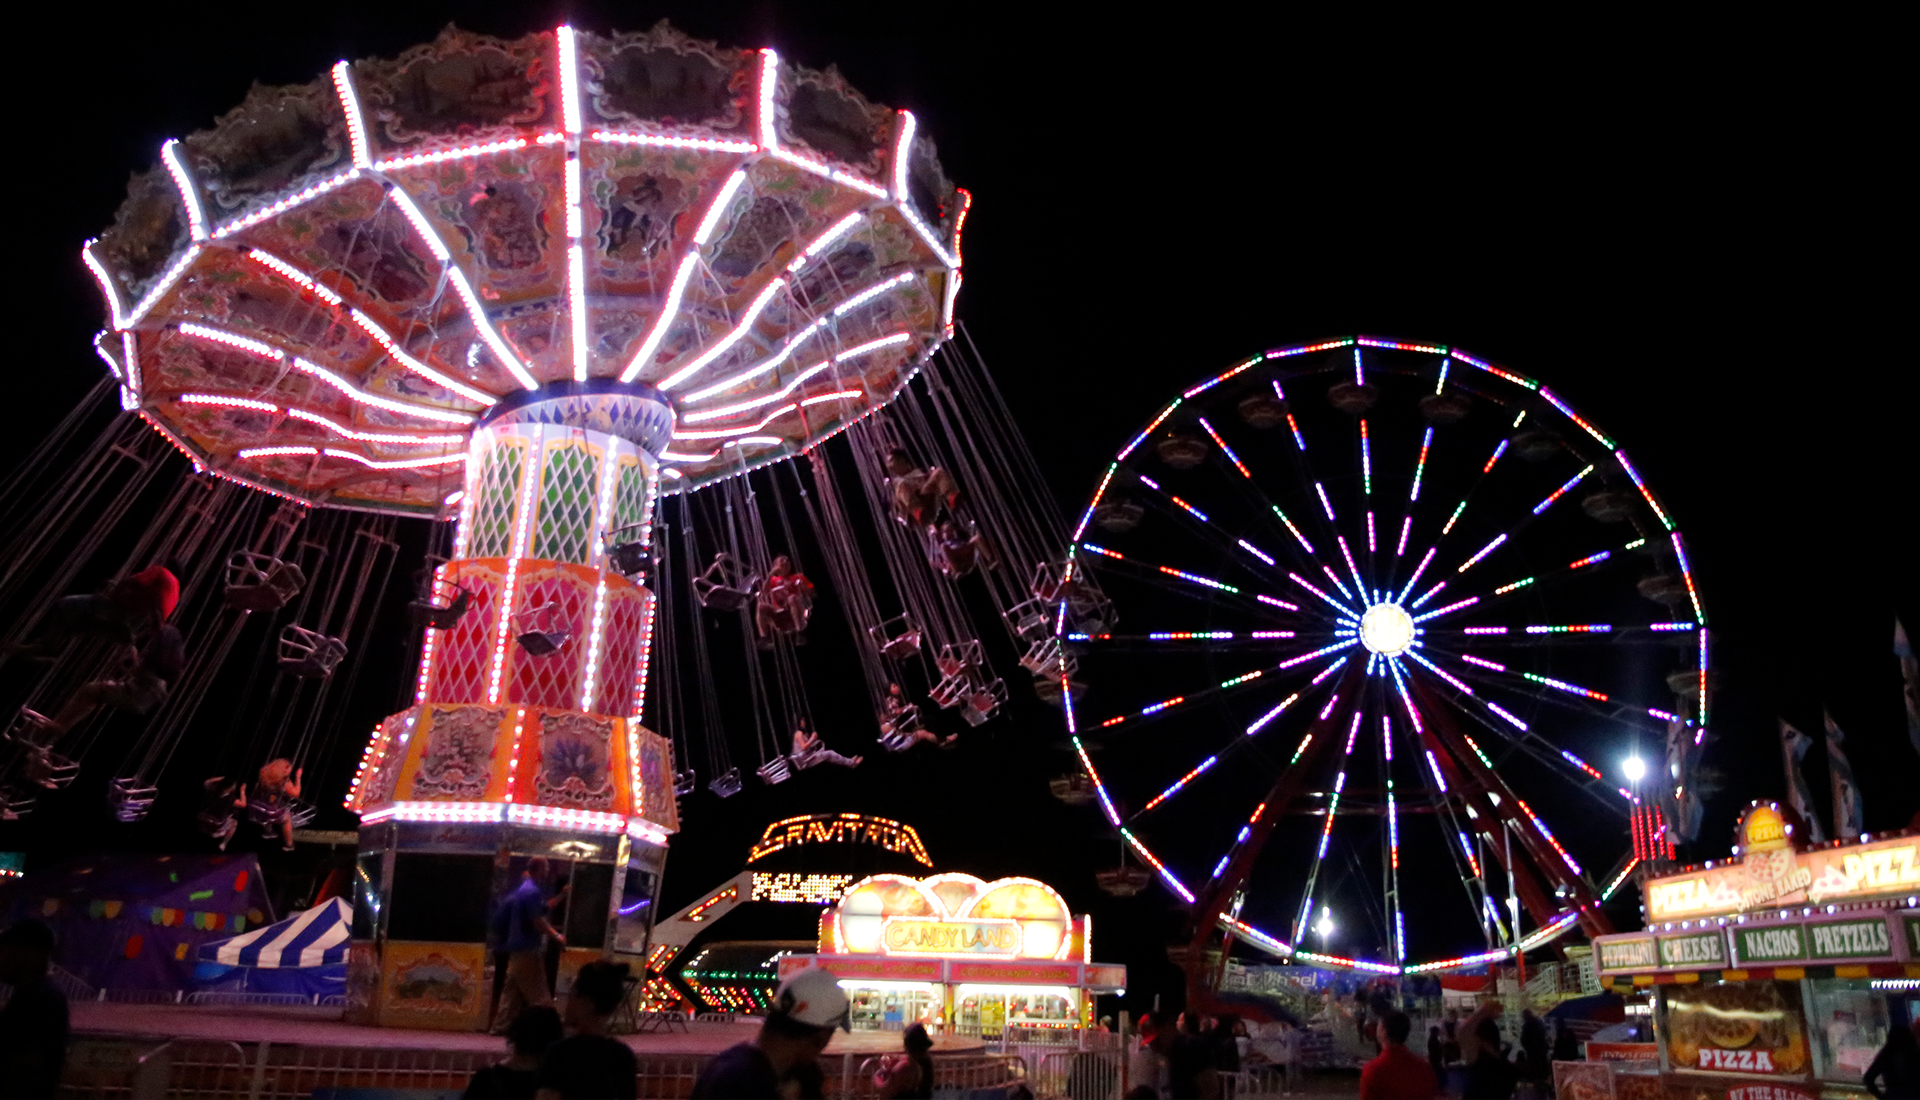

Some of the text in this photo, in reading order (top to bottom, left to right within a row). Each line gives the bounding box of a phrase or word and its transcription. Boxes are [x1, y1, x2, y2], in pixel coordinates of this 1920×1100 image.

[746, 813, 933, 868] GRAVITRON
[1777, 867, 1811, 896] BAKED
[1649, 878, 1715, 914] PIZZA
[892, 926, 1016, 948] CANDY LAND
[1664, 935, 1720, 962] CHEESE
[1745, 928, 1800, 958] NACHOS
[1813, 922, 1889, 954] PRETZELS
[1602, 942, 1653, 967] PEPPERONI
[1699, 1049, 1773, 1071] PIZZA
[1747, 1086, 1771, 1100] THE
[1774, 1088, 1813, 1100] SLIC
